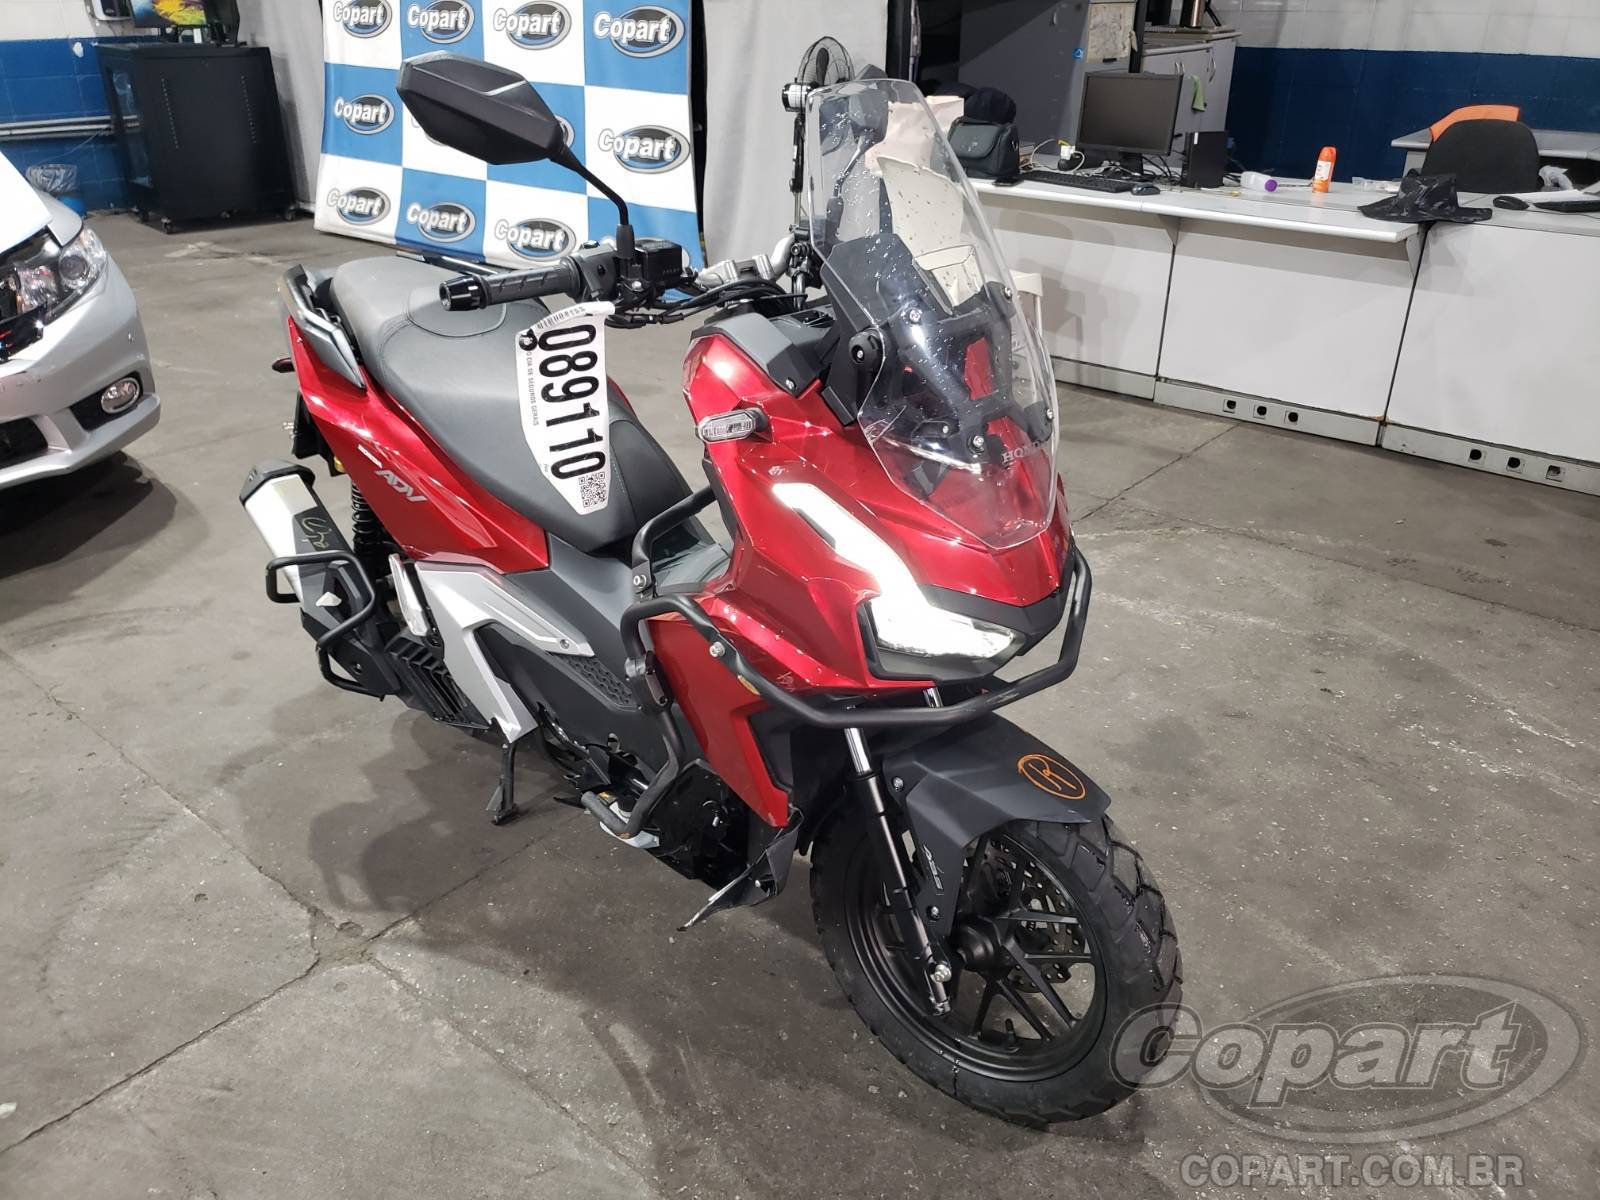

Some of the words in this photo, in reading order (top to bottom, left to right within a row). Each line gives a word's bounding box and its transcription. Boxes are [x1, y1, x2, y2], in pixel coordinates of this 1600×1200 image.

[333, 2, 385, 28] Copart
[407, 4, 467, 32] Copart
[493, 8, 562, 37] Copart
[594, 11, 674, 44] Copart
[334, 98, 387, 126] Copart
[598, 128, 679, 164] Copart
[327, 188, 383, 217] Copart
[406, 202, 468, 232] Copart
[494, 219, 566, 250] Copart
[538, 324, 606, 480] 089110
[374, 469, 428, 502] ADV
